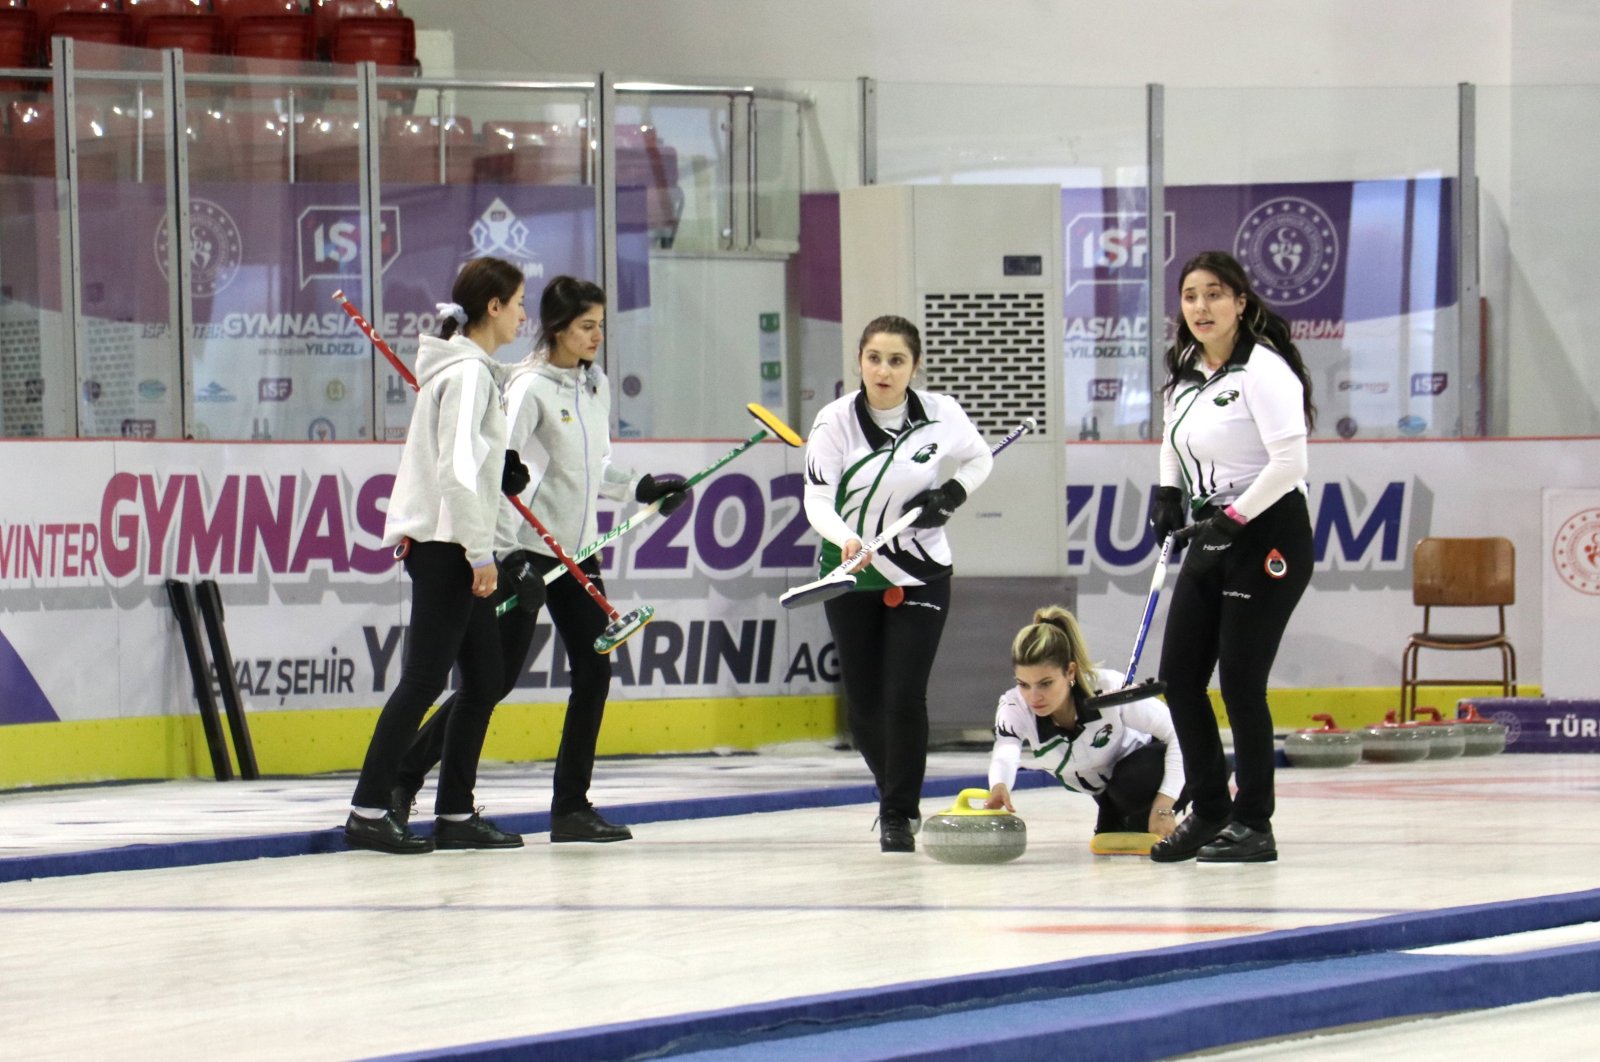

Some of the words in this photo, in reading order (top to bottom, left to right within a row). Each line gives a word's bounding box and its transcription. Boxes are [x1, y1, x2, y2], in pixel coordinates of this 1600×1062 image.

[313, 221, 387, 264] IS
[223, 312, 399, 338] GYMNASIAE
[1414, 376, 1444, 394] ISF
[634, 473, 817, 571] 202
[275, 646, 355, 706] ŞEHİR
[1546, 714, 1600, 738] TÜR
